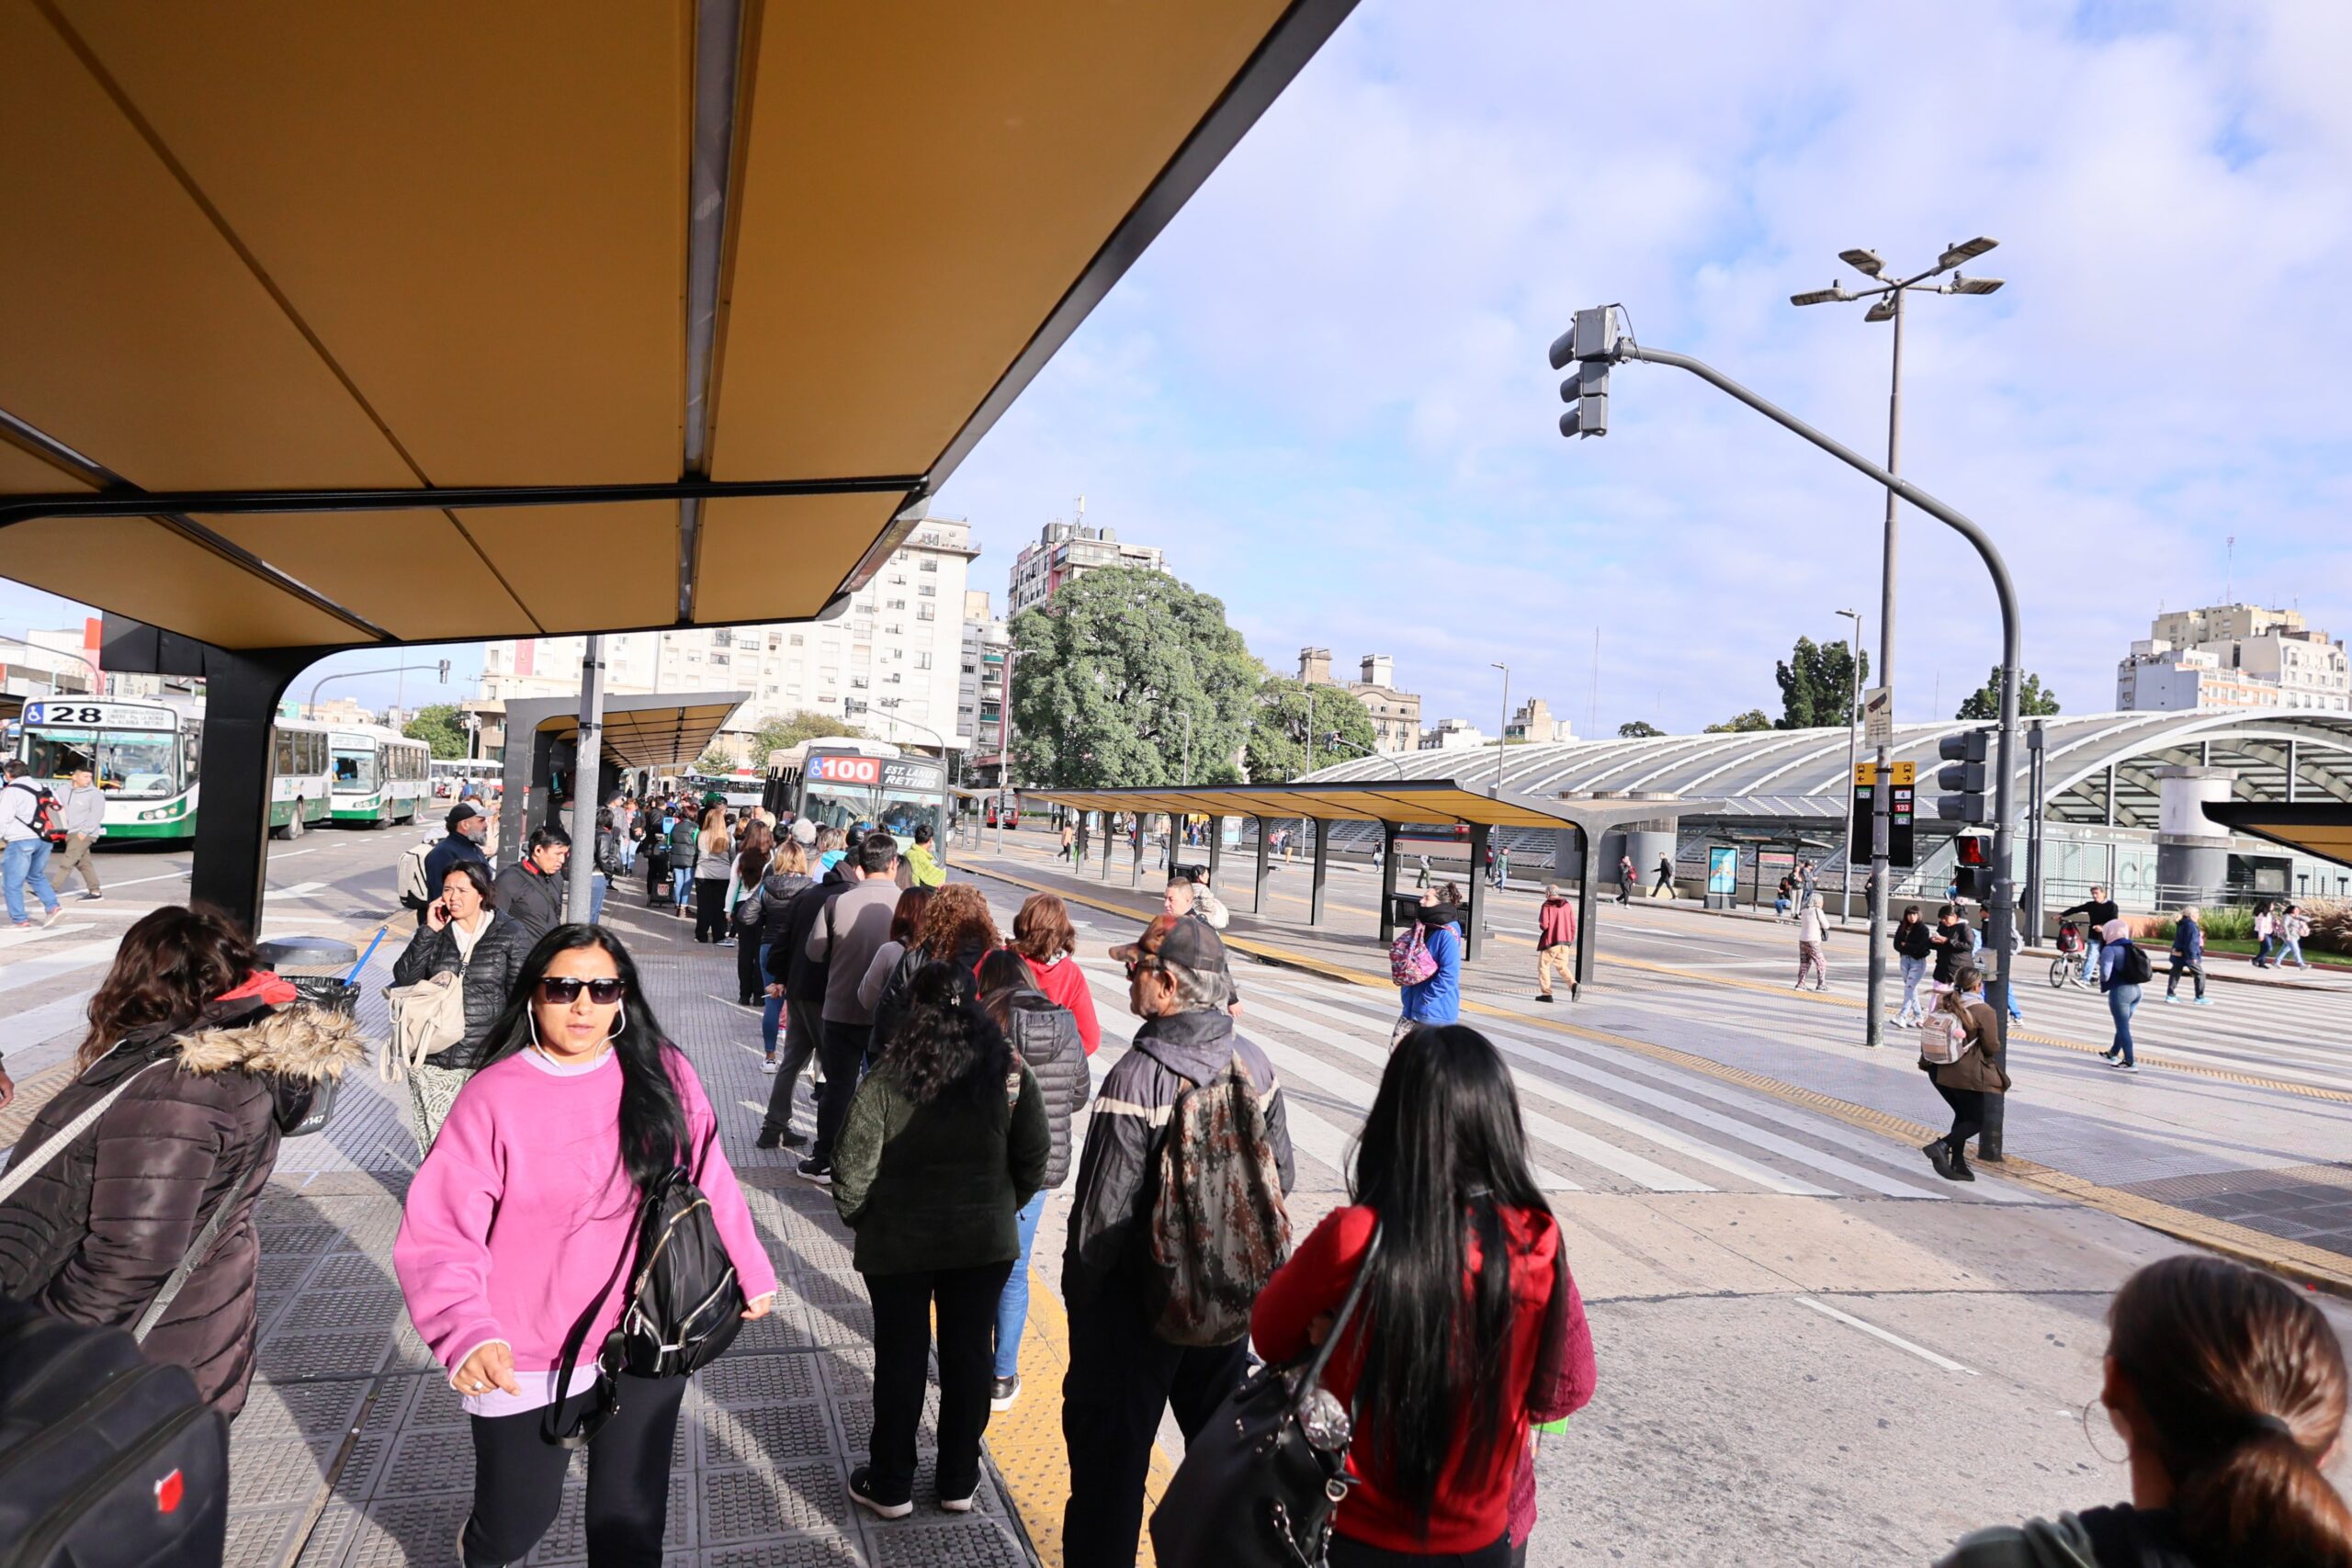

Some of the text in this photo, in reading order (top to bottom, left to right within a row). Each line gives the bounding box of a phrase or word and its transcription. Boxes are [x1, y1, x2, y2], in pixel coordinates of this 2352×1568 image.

[51, 706, 102, 723] 28
[822, 759, 874, 780] 100
[884, 765, 939, 780] EST. LANUS
[885, 775, 936, 789] RETIRO
[1896, 804, 1909, 812] 133
[1897, 817, 1907, 825] 62
[1394, 841, 1404, 852] 151
[309, 1114, 324, 1124] 147
